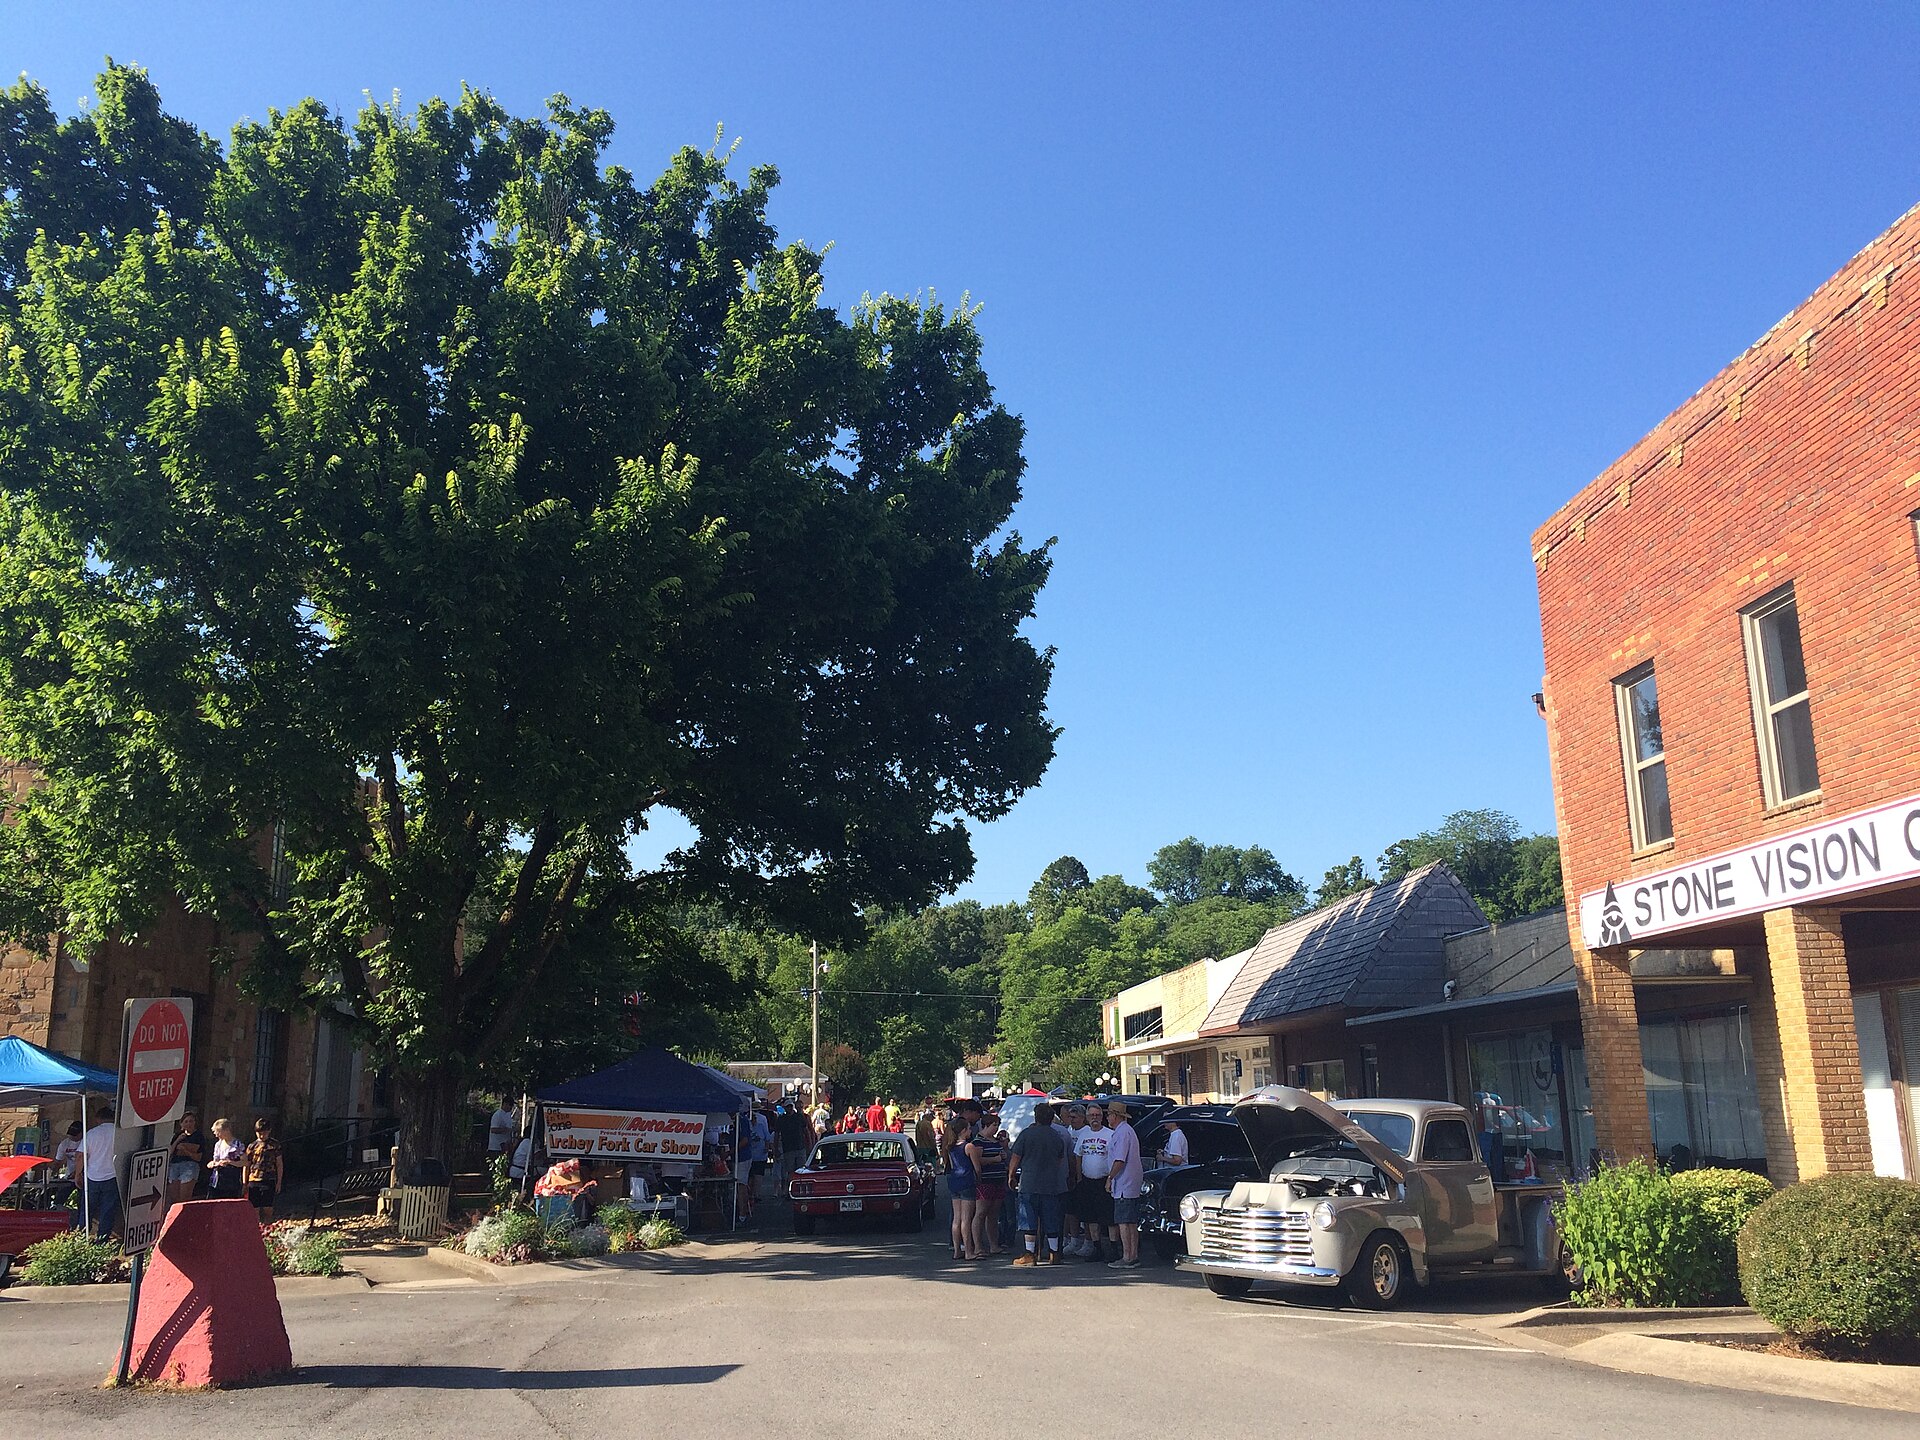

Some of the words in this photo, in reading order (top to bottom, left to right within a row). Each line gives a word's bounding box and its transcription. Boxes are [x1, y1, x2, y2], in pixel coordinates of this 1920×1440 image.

[1634, 862, 1736, 927] STONE
[1751, 822, 1881, 897] VISION
[140, 1025, 155, 1044] DO
[161, 1023, 183, 1042] NOT
[138, 1077, 174, 1099] ENTER
[628, 1116, 703, 1135] AutoZone
[598, 1136, 630, 1152] Fork
[634, 1138, 657, 1154] Car
[661, 1139, 700, 1156] Show
[136, 1155, 163, 1180] KEEP
[127, 1220, 160, 1249] RIGHT
